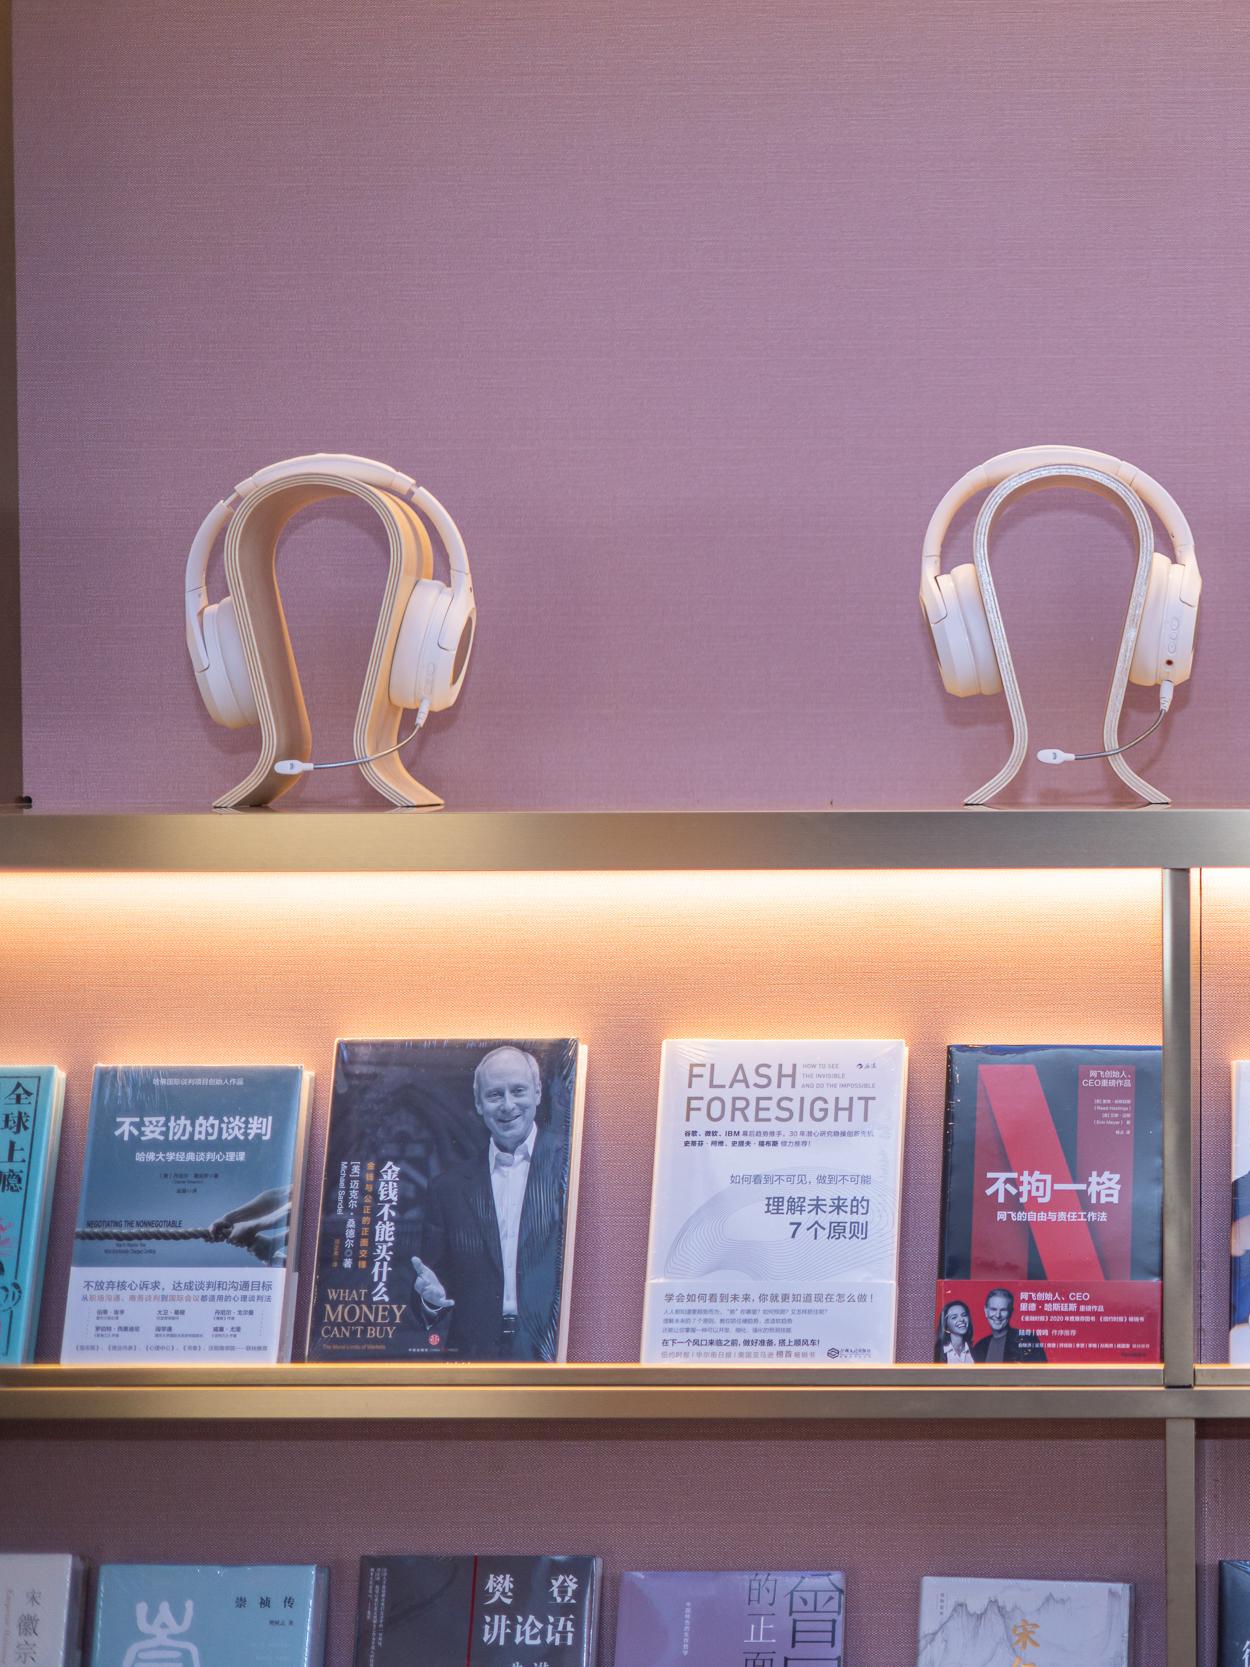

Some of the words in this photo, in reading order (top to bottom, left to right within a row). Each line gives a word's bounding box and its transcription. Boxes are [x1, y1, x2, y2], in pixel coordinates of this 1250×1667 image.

[687, 1063, 797, 1089] FLASH
[685, 1095, 877, 1123] FORESIGHT
[114, 1115, 273, 1141] 不妥协的谈判
[135, 1151, 246, 1162] 哈佛大学经典谈判心理课
[729, 1173, 872, 1186] 如何看到不可见，做到不可能
[985, 1170, 1122, 1204] 不拘一格
[765, 1195, 870, 1217] 理解未来的
[996, 1210, 1108, 1222] 网飞的自由与责任工作法
[86, 1220, 122, 1228] NEGOTIATING
[124, 1220, 134, 1228] THE
[135, 1220, 183, 1228] NONNEGOTIABLE
[371, 1161, 400, 1302] 金钱不能买什么
[327, 1289, 368, 1301] WHAT
[324, 1304, 407, 1323] MONEY
[321, 1326, 364, 1338] CAN'T
[367, 1326, 397, 1338] BUY
[483, 1573, 579, 1605] 樊登
[482, 1614, 575, 1646] 讲论语
